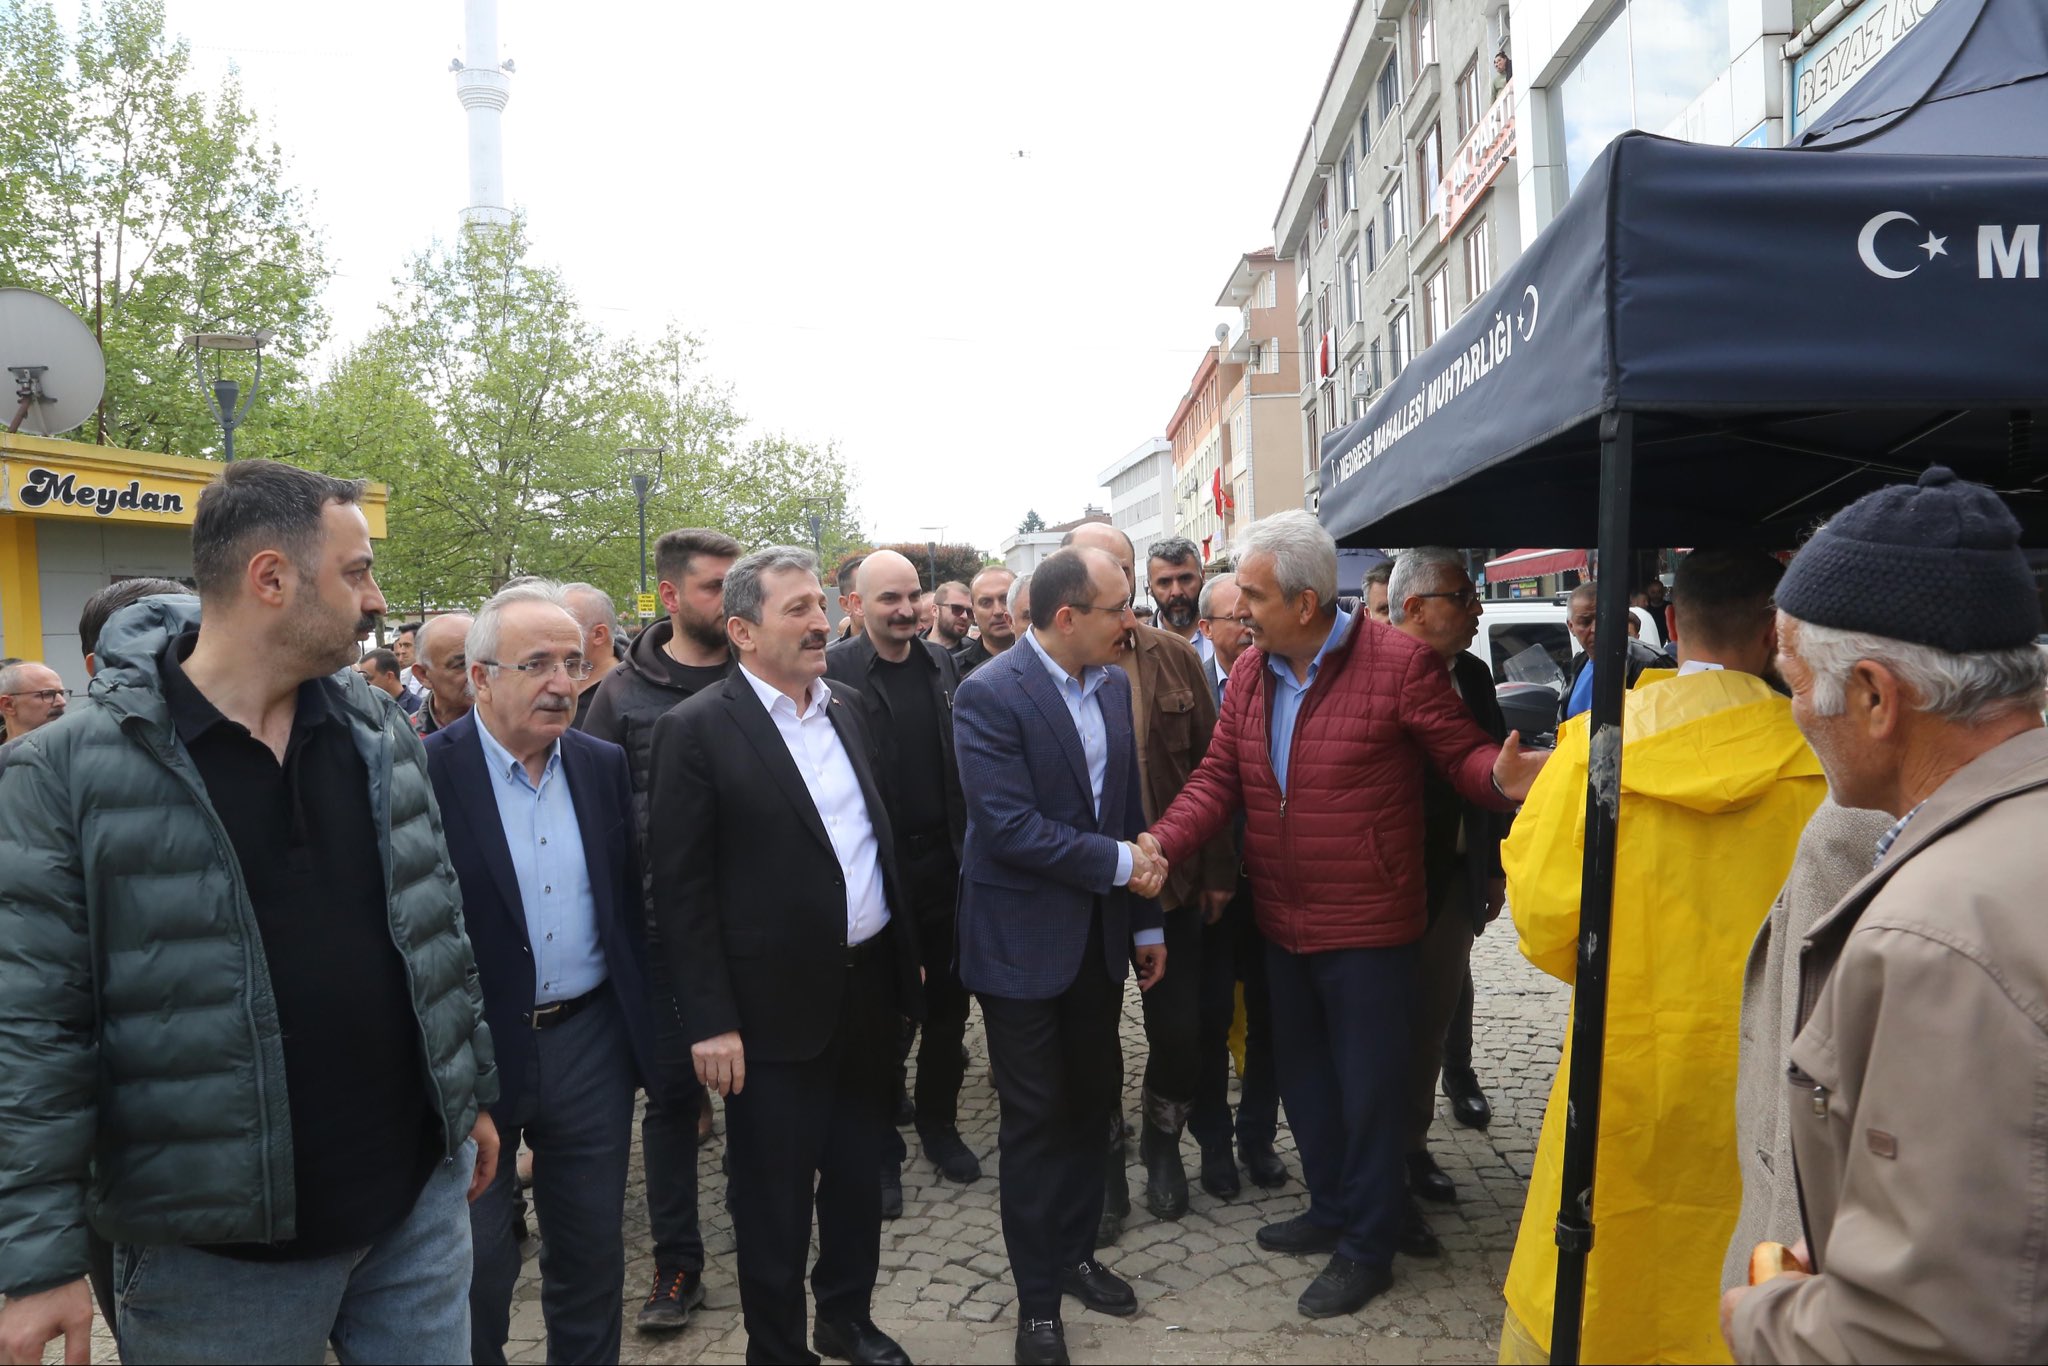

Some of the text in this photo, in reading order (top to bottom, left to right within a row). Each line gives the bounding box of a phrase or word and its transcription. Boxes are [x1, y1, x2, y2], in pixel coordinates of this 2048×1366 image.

[1796, 4, 1887, 117] BEYAZ
[1453, 148, 1473, 195] AK
[1339, 310, 1513, 483] MEDRESE MAHALLESİ MUHTARLIĞI
[19, 467, 184, 516] Meydan
